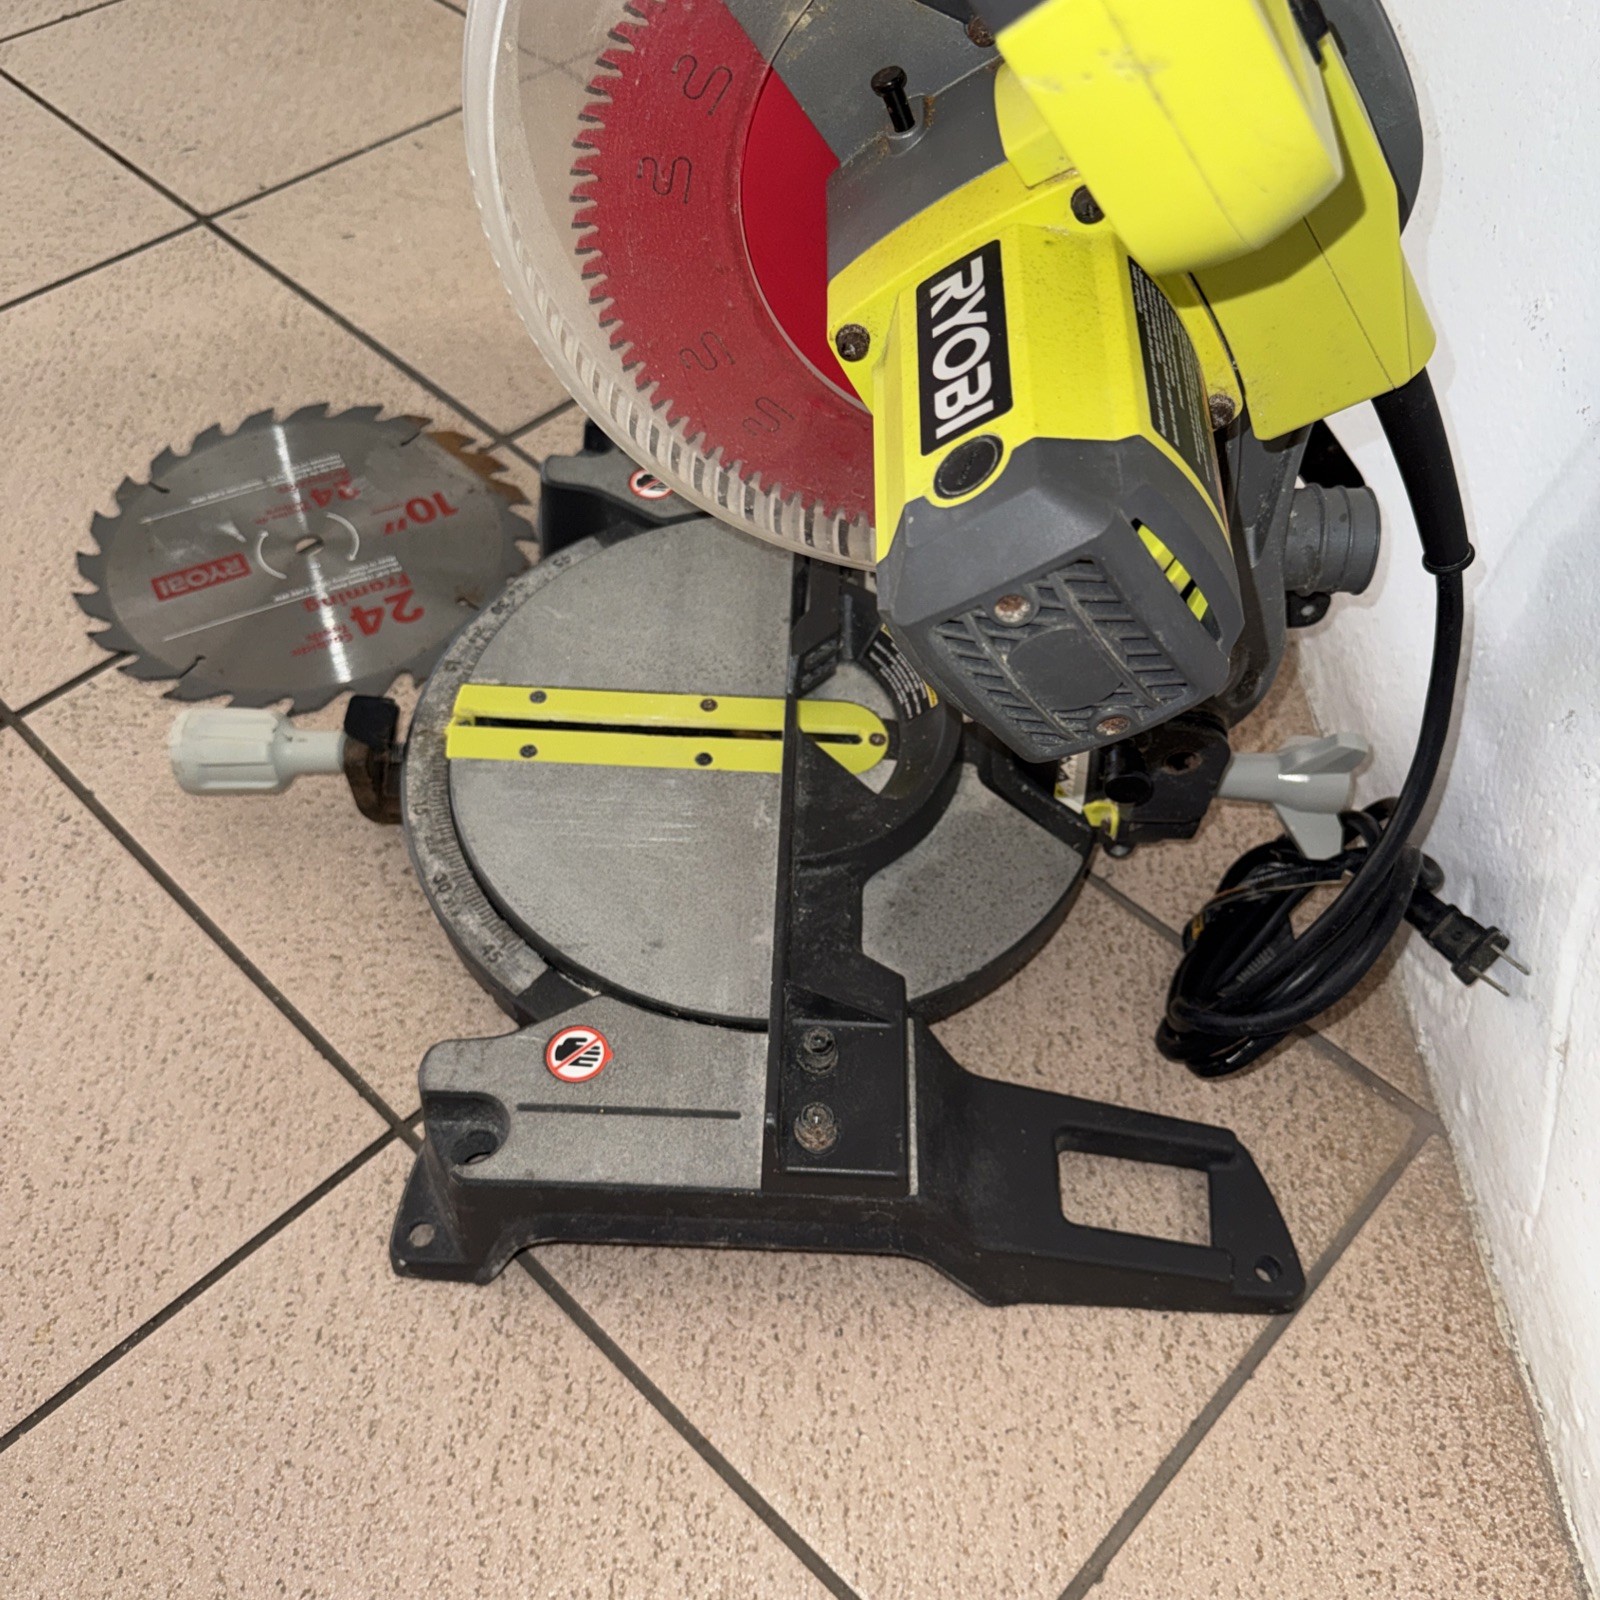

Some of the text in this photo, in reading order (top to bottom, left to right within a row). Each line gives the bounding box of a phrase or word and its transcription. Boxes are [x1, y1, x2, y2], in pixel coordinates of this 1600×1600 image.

[930, 255, 994, 440] RYOBI
[158, 558, 245, 597] RYOBI
[303, 571, 413, 613] Framing
[350, 588, 424, 635] 24
[291, 631, 354, 656] Cabide
[304, 623, 349, 641] Teth
[433, 872, 452, 893] 30
[482, 943, 504, 964] 45
